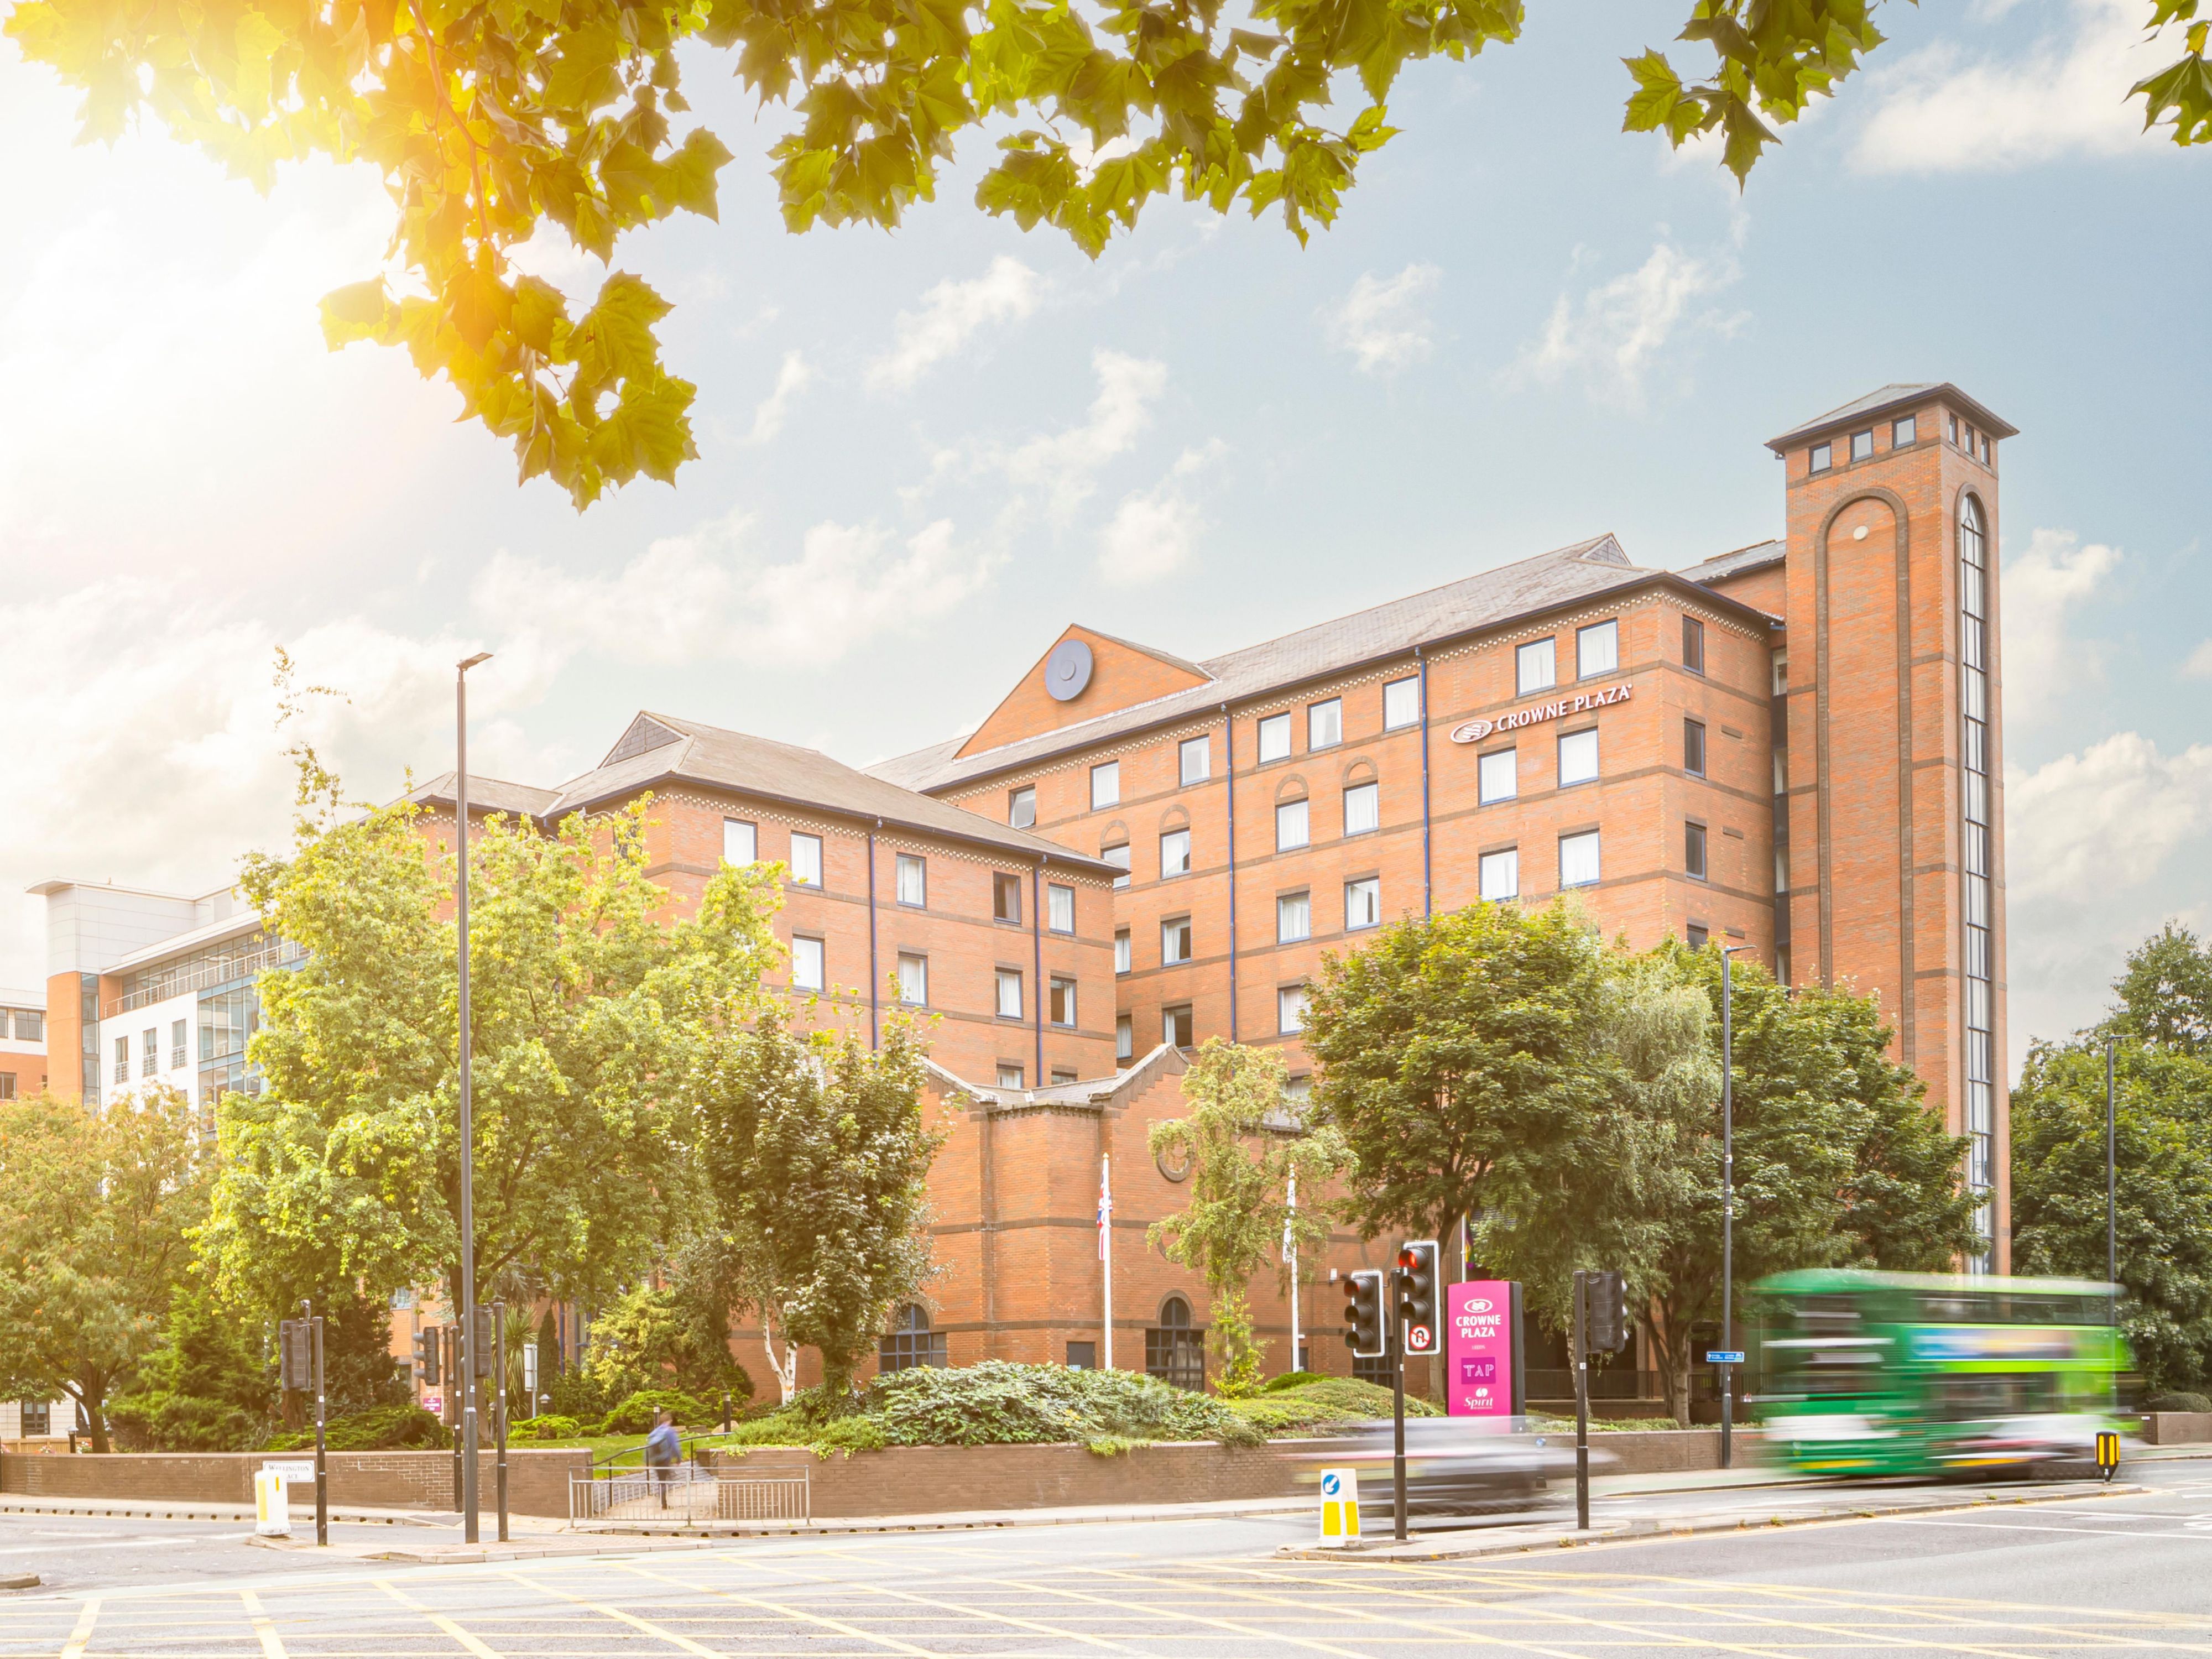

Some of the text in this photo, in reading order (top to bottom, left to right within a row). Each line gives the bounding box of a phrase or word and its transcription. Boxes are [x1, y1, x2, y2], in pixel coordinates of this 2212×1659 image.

[1497, 685, 1630, 732] CROWNE PLAZA
[1456, 1314, 1501, 1327] CROWNE
[1462, 1327, 1495, 1338] PLAZA
[1463, 1364, 1494, 1377] TAP
[1464, 1397, 1493, 1410] Spirit
